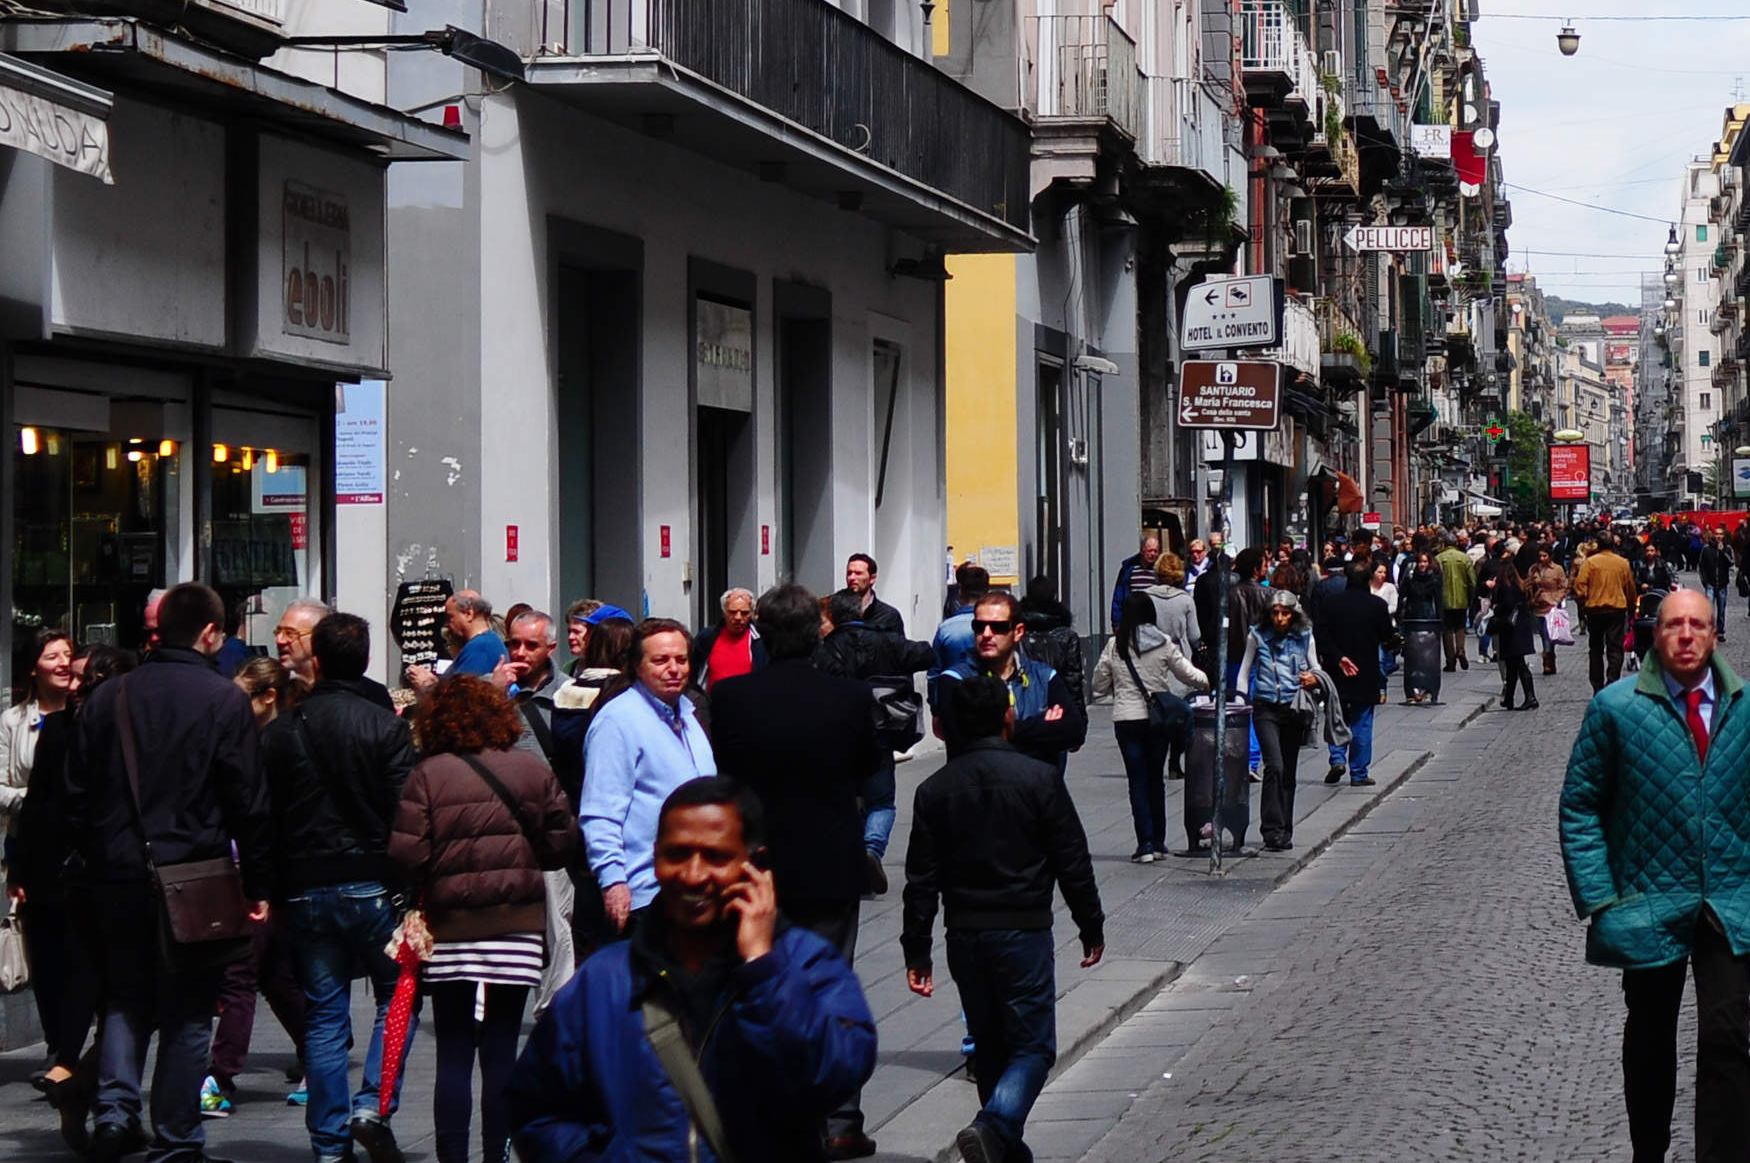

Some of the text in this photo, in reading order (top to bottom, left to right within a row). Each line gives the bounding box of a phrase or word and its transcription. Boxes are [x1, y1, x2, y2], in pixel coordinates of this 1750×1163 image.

[1355, 229, 1429, 248] PELLICCE
[287, 240, 348, 334] eboli
[1187, 326, 1212, 341] HOTEL
[1224, 322, 1269, 338] CONVENTO
[1199, 385, 1256, 396] SANTUARIO
[1182, 397, 1273, 408] S. Maria Francesca
